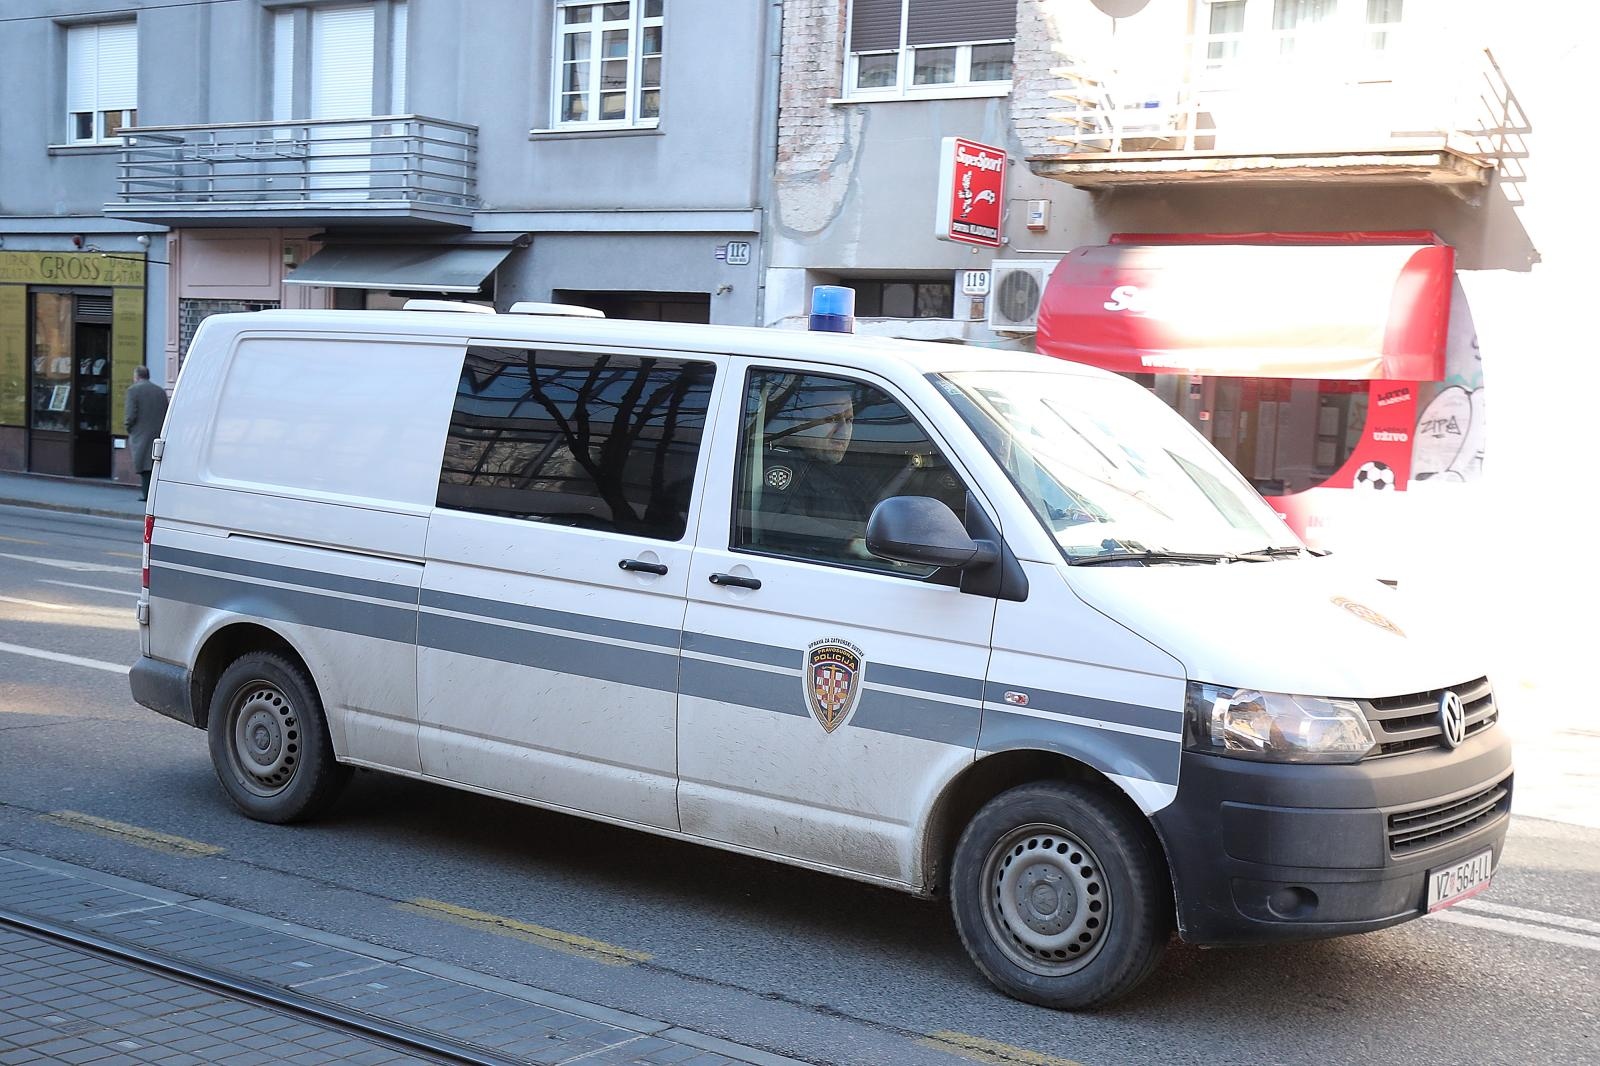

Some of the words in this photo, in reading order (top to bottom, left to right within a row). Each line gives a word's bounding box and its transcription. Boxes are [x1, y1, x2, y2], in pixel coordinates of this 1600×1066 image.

[956, 147, 1002, 171] SuperSport
[730, 243, 748, 257] 117
[40, 256, 101, 281] GROSS
[103, 270, 142, 282] ZLATAR
[966, 272, 986, 287] 119
[1378, 387, 1410, 401] LOTO
[813, 653, 856, 669] POLICIJA
[1436, 871, 1450, 901] VZ
[1457, 855, 1489, 893] 564-LL
